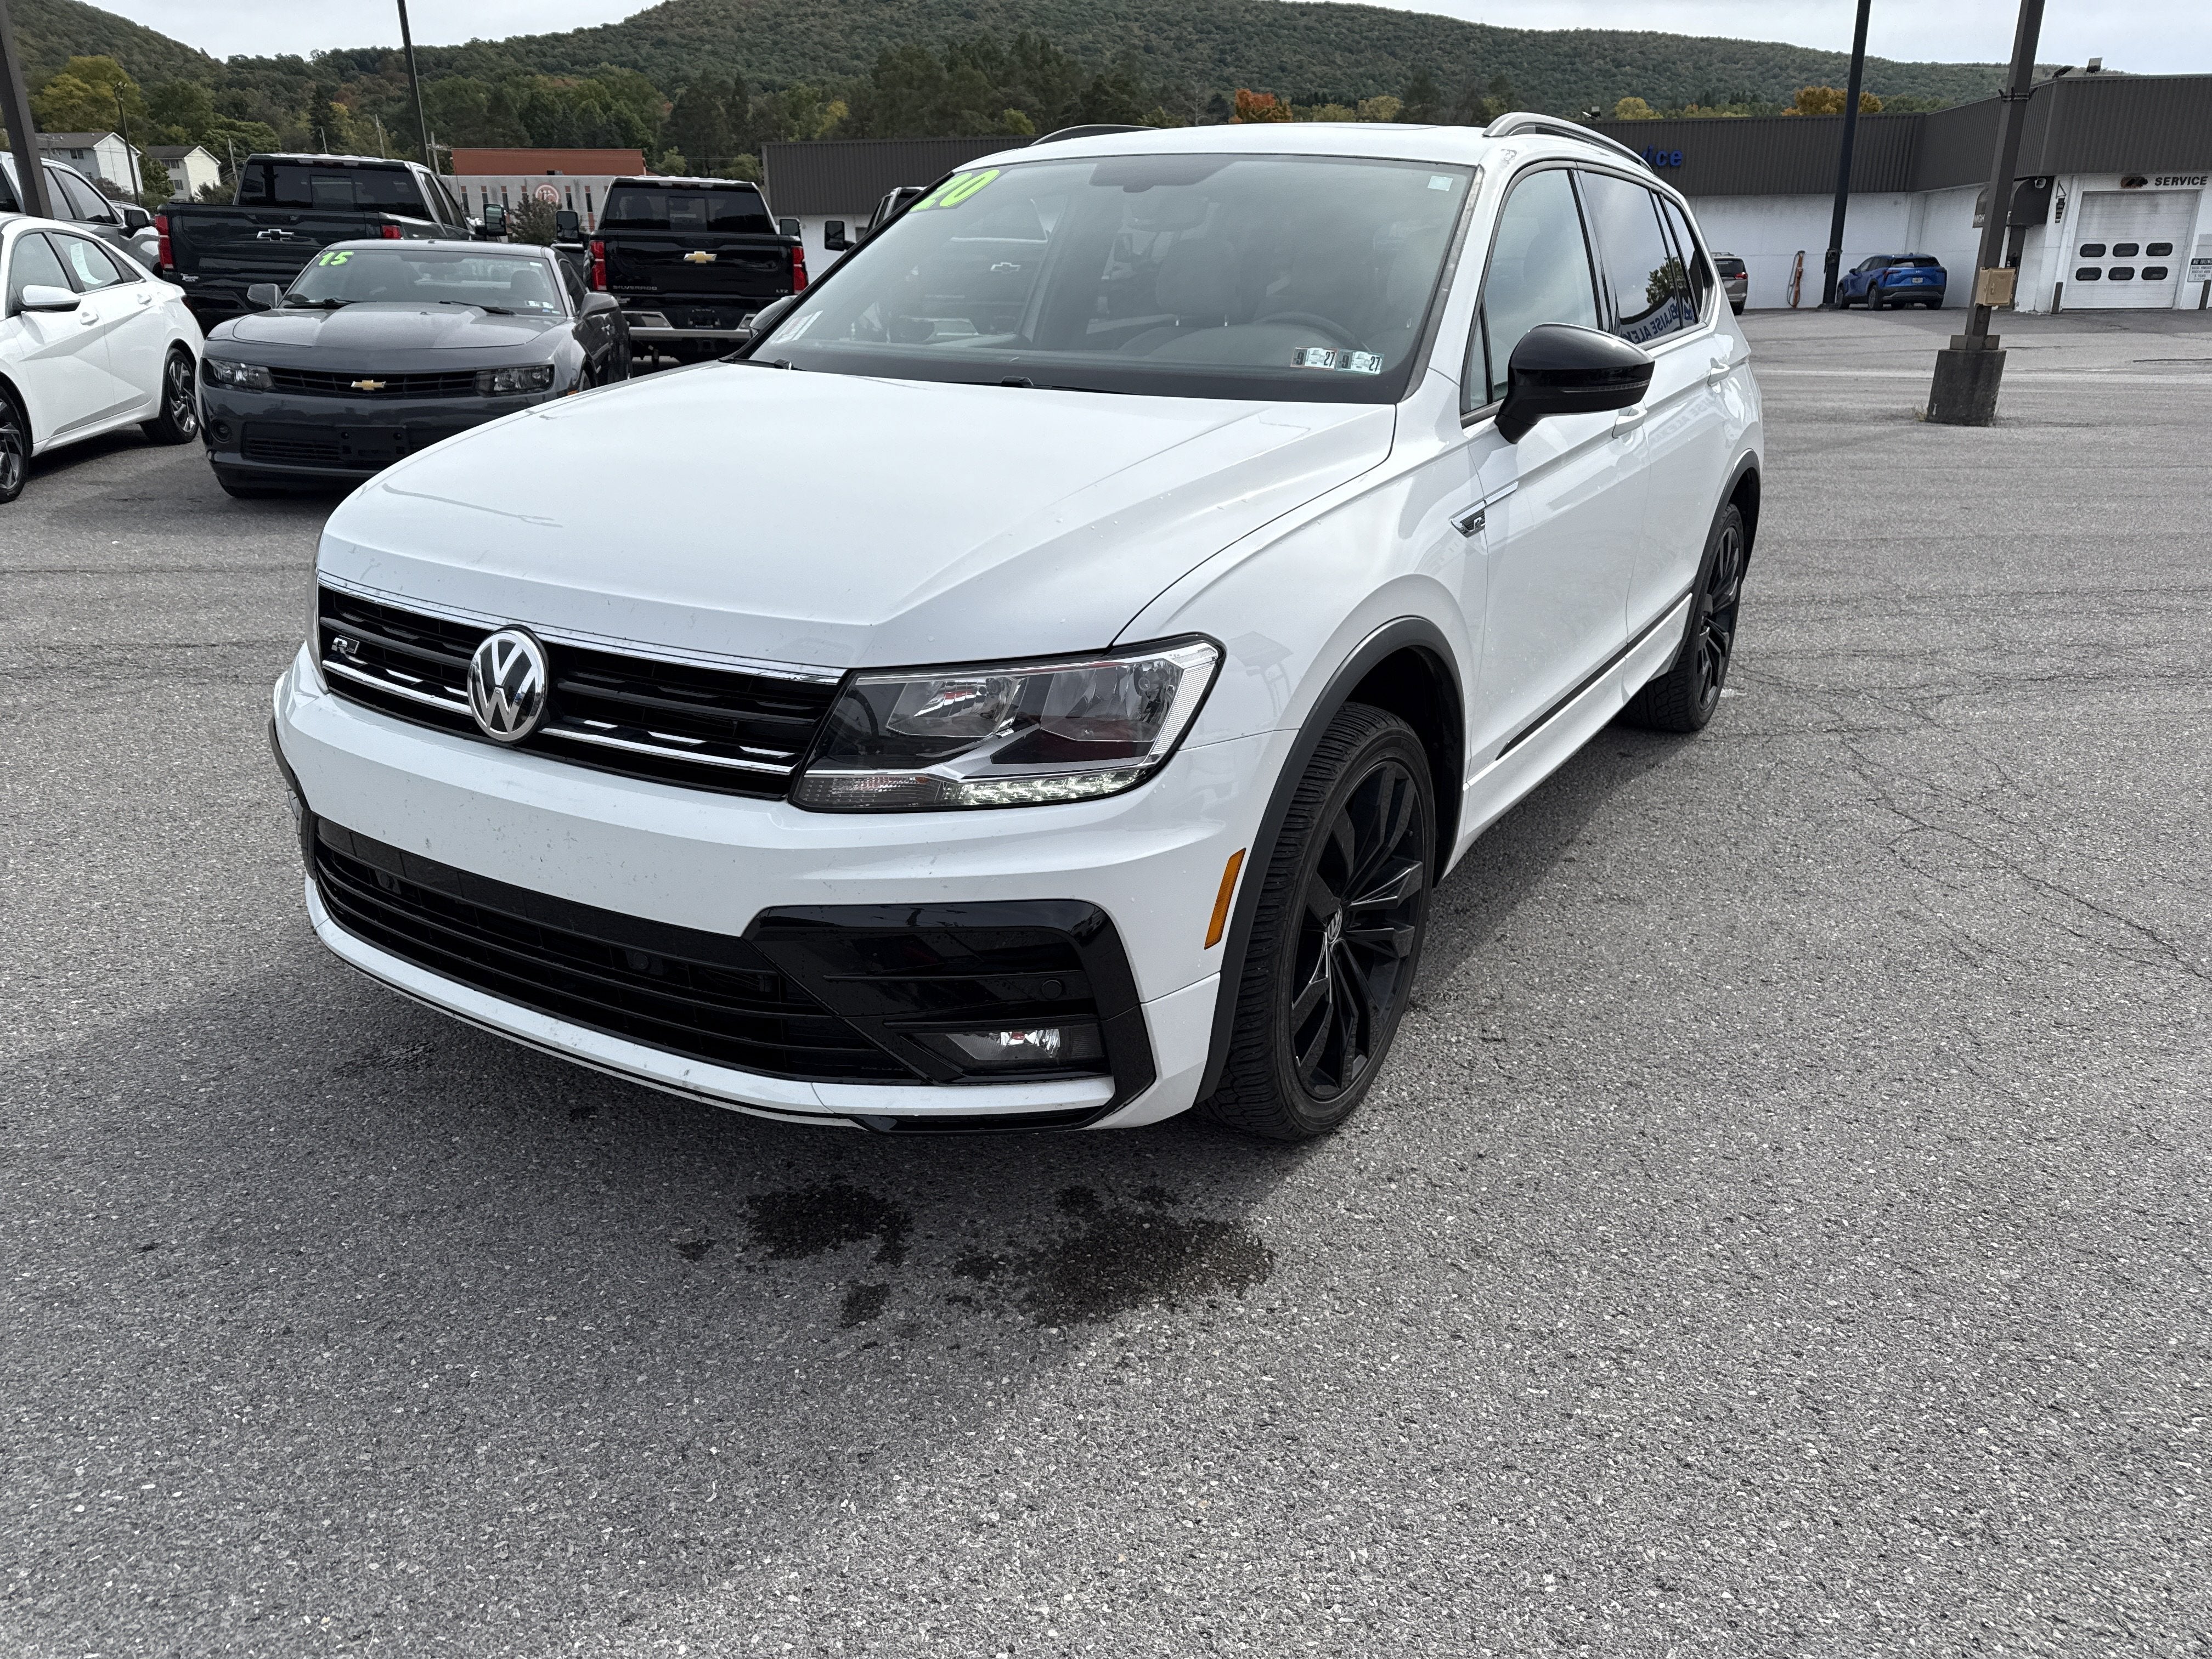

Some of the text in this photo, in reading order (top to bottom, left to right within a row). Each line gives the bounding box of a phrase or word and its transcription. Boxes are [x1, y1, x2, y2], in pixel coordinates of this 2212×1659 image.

[2154, 176, 2208, 186] SERVICE
[910, 170, 1001, 212] 20
[318, 251, 354, 266] 15
[1323, 351, 1336, 368] 27
[1368, 356, 1381, 372] 27
[468, 629, 548, 742] VW
